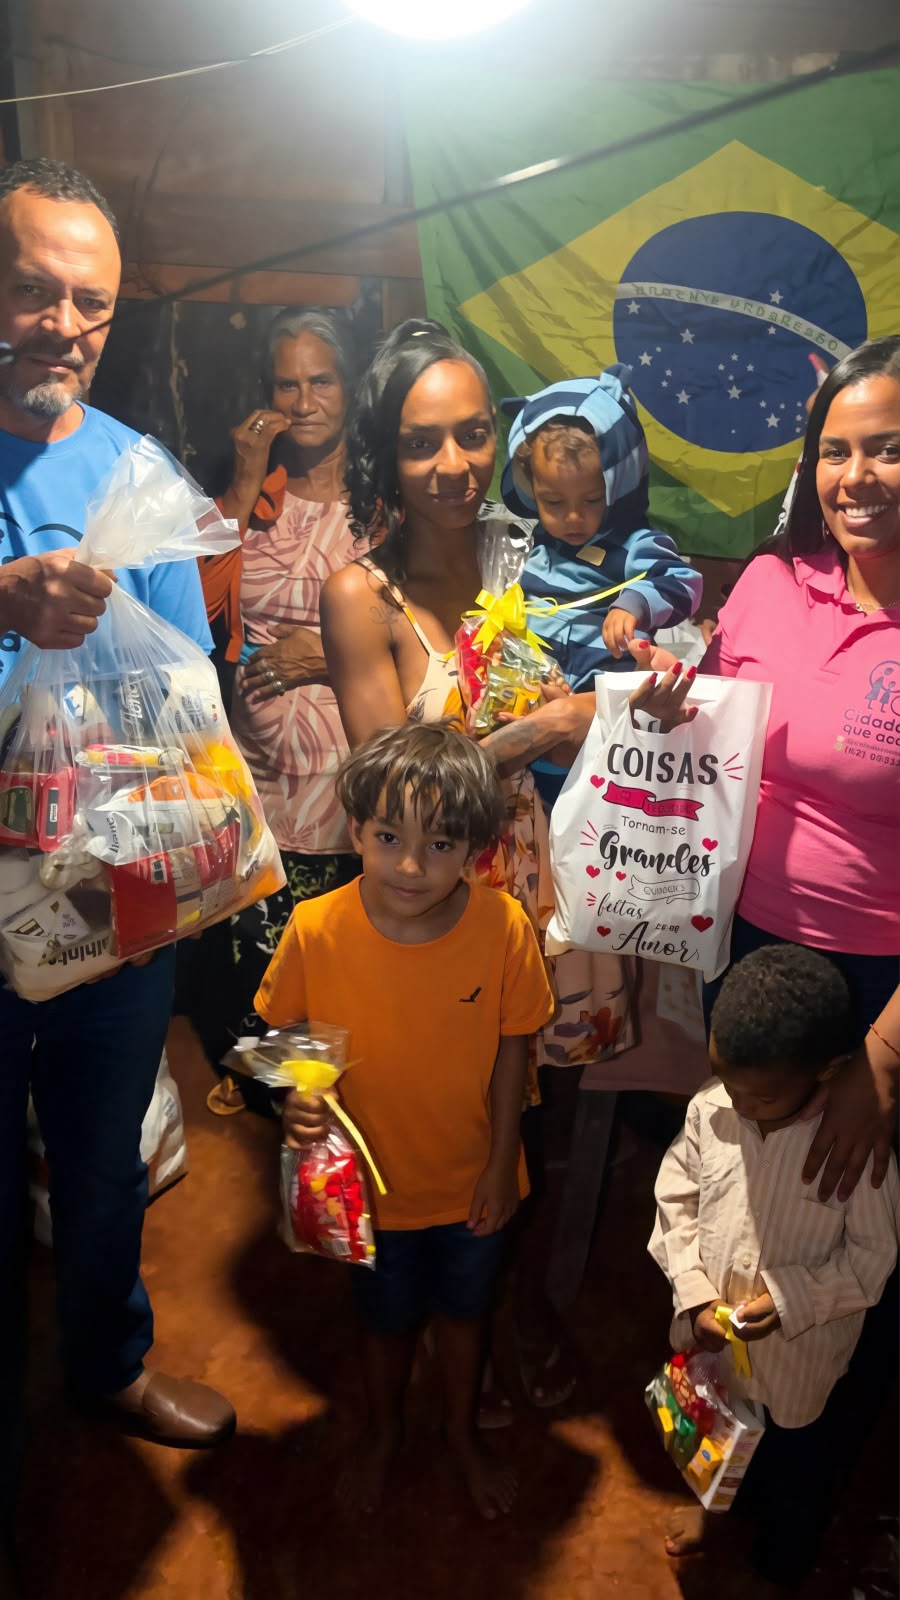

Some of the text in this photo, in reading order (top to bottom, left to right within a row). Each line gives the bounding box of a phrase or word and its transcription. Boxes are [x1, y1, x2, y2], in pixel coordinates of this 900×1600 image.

[843, 724, 872, 739] que
[607, 743, 719, 785] COISAS
[621, 815, 686, 835] Tornam-se
[600, 830, 715, 877] Grandes
[612, 921, 699, 963] Amor
